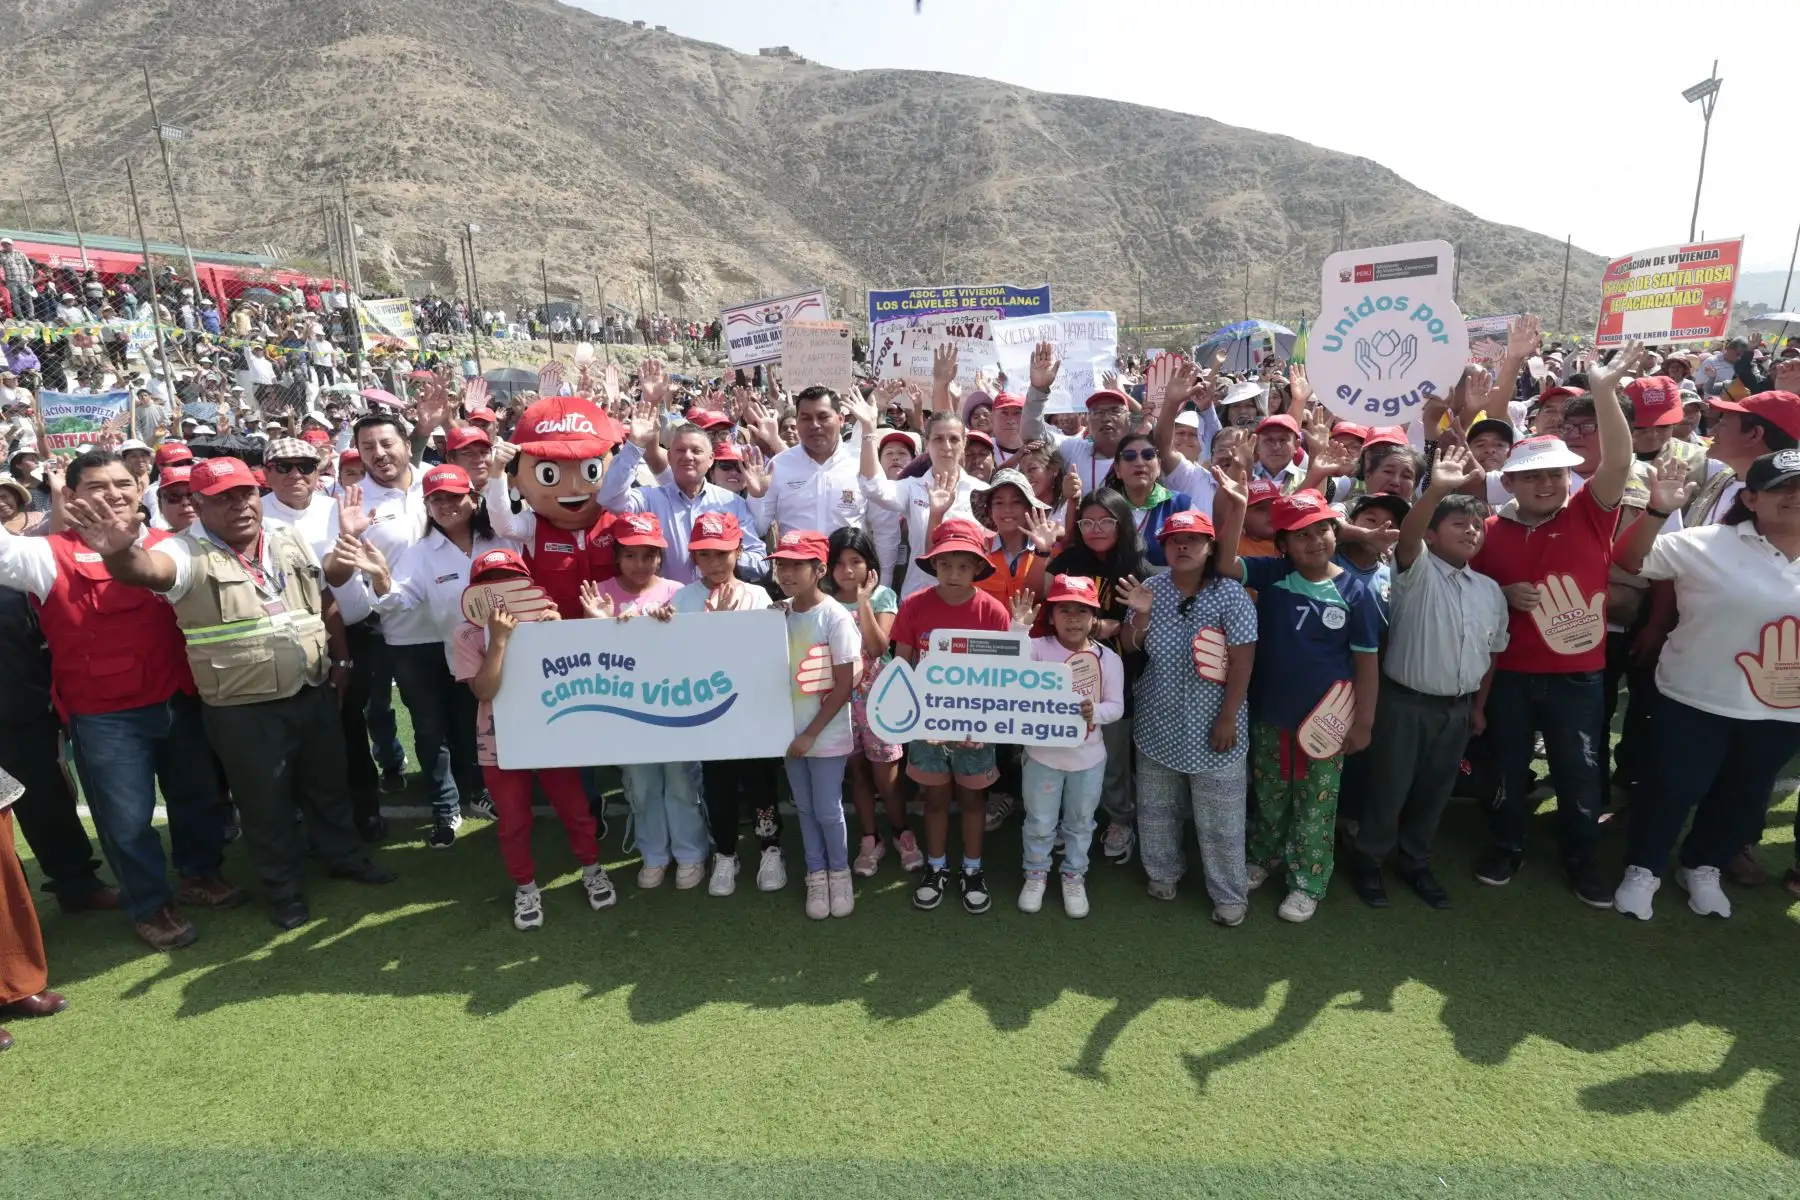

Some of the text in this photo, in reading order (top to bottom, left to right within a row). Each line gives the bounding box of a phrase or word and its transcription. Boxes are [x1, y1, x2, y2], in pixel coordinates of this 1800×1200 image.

[1653, 257, 1666, 267] DE
[1668, 249, 1719, 264] VIVIENDA
[1635, 275, 1651, 291] DE
[1652, 270, 1693, 288] SANTA
[1695, 264, 1733, 284] ROSA
[876, 296, 1040, 311] LOS CLAVELES DE COLLANAC
[909, 287, 1006, 299] ASOC. DE VIVIENDA
[1620, 289, 1702, 311] PACHACAMAC
[946, 322, 984, 340] HAYA
[1322, 295, 1409, 352] Unidos
[1409, 303, 1449, 345] por
[1643, 330, 1668, 339] ENERO
[1670, 329, 1684, 337] DEL
[1686, 327, 1710, 336] 2009
[730, 335, 753, 349] VICTOR
[770, 329, 782, 341] HAY
[998, 327, 1035, 345] VICTOR
[872, 337, 894, 385] ICTOR
[1336, 380, 1437, 417] el agua
[74, 404, 114, 418] PROPIETA
[1295, 606, 1311, 631] 7
[1545, 613, 1600, 636] CORRUPCIÓN
[1551, 608, 1585, 626] ALTO
[541, 652, 636, 679] Agua que
[926, 664, 1064, 691] COMIPOS:
[540, 673, 634, 708] cambia
[924, 692, 1080, 716] transparentes
[924, 718, 1078, 741] como el agua
[1323, 712, 1346, 735] ALTO
